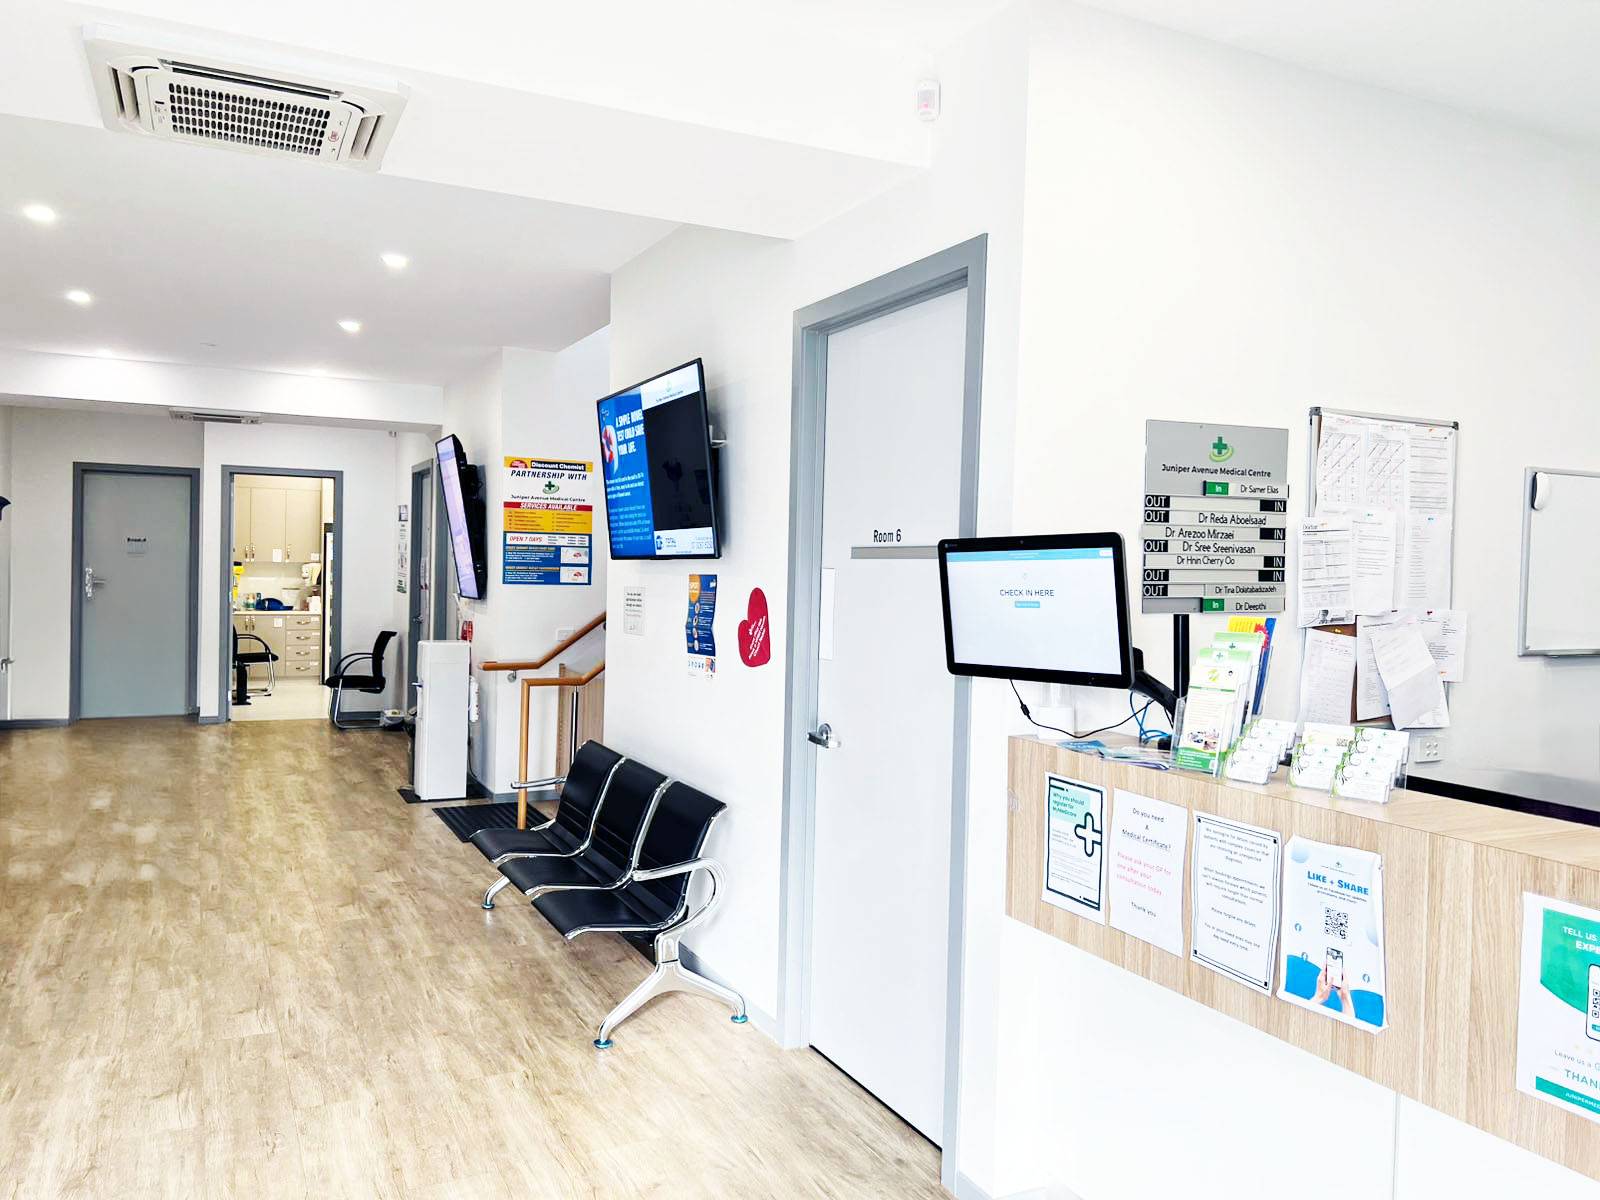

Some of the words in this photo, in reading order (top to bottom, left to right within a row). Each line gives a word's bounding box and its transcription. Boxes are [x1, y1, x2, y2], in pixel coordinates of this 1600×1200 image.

[511, 470, 565, 479] PARTNERSHIP
[1162, 464, 1190, 473] Juniper
[1191, 466, 1218, 474] Avenue
[1220, 467, 1247, 476] Medical
[1248, 469, 1271, 477] Centre
[1145, 496, 1166, 507] OUT
[1275, 501, 1284, 512] IN
[1145, 511, 1166, 521] OUT
[1199, 513, 1208, 523] Dr
[1210, 513, 1227, 524] Reda
[1230, 514, 1266, 525] Aboelsaad
[874, 530, 893, 542] Room
[896, 529, 901, 542] 6
[1165, 527, 1175, 537] Dr
[1178, 528, 1206, 539] Arezoo
[1208, 528, 1234, 539] Mirzaei
[1274, 529, 1283, 540] IN
[1145, 541, 1165, 551] OUT
[1182, 541, 1192, 552] Dr
[1195, 542, 1211, 552] Sree
[1213, 543, 1255, 553] Sreenivasan
[1177, 556, 1185, 565] Dr
[1201, 557, 1223, 567] Cherry
[1226, 556, 1235, 565] Oo
[1274, 557, 1283, 567] IN
[1145, 570, 1165, 580] OUT
[1273, 571, 1282, 581] IN
[1144, 586, 1164, 596] OUT
[1236, 603, 1243, 611] Dr
[1244, 602, 1266, 611] Deepthi
[1122, 829, 1141, 839] Medical
[1118, 851, 1132, 861] Please
[1140, 872, 1152, 880] your
[1117, 874, 1146, 888] consultation
[1147, 884, 1162, 897] today
[1307, 870, 1327, 883] LIKE
[1337, 879, 1368, 895] SHARE
[1131, 901, 1146, 912] Thank
[1147, 909, 1156, 918] you
[1562, 926, 1583, 938] TELL
[1586, 932, 1597, 941] US
[1554, 1049, 1574, 1061] Leave
[1565, 1069, 1600, 1090] THAN
